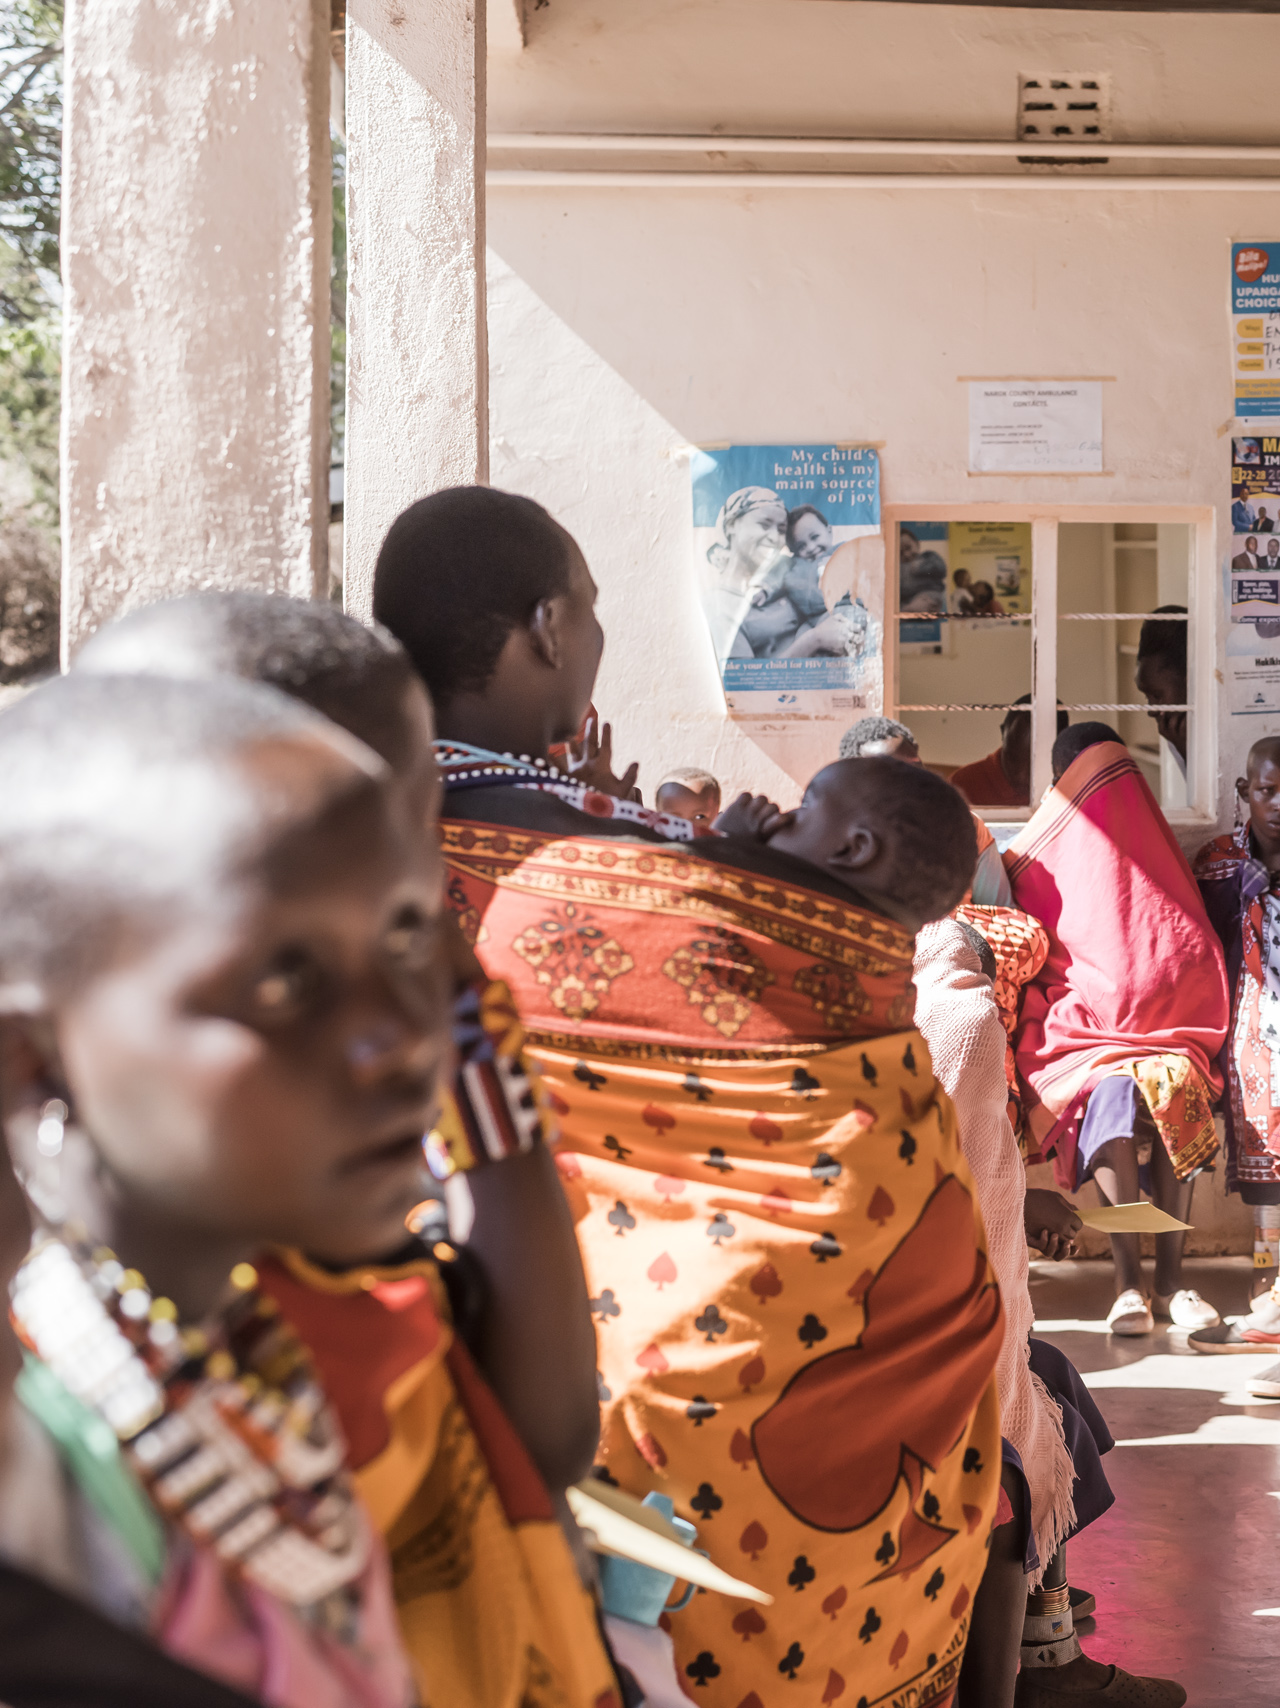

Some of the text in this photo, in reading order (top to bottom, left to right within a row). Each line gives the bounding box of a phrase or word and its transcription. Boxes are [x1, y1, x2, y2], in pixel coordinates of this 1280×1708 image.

[1239, 250, 1260, 264] Bila
[791, 448, 876, 464] My child's
[774, 463, 875, 478] health is my
[1242, 470, 1266, 480] 22-28
[775, 478, 875, 490] main source
[828, 490, 875, 507] of joy
[743, 660, 822, 672] your child for HIV
